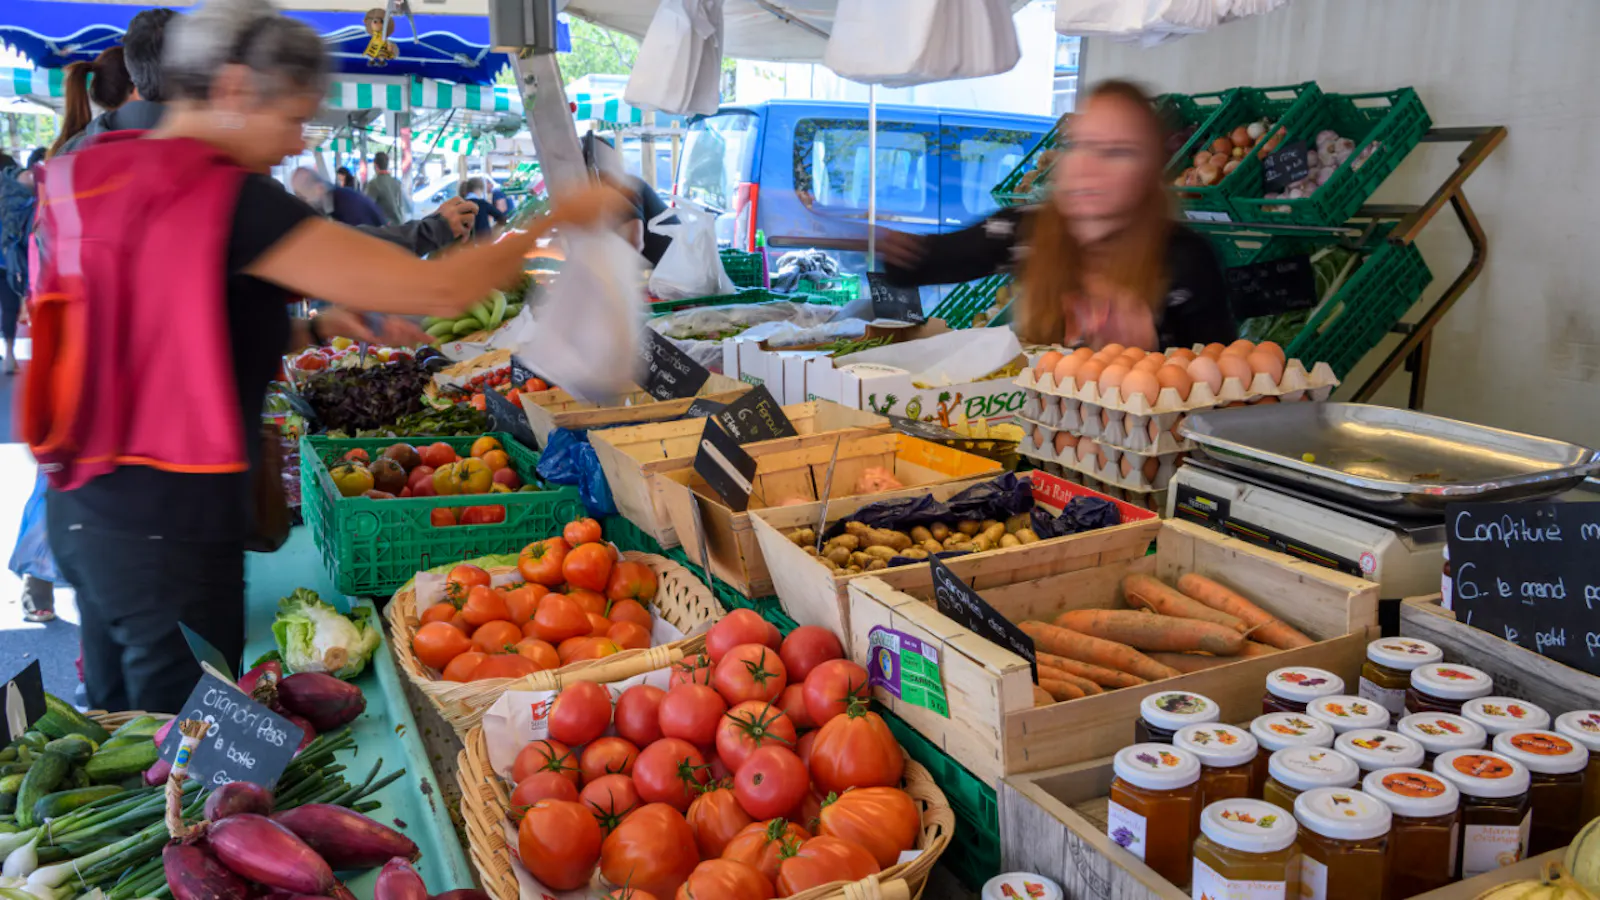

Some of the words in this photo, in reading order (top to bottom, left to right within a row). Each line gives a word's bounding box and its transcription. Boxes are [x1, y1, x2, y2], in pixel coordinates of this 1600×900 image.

[964, 391, 1026, 419] BISC
[1039, 478, 1050, 496] La
[1053, 483, 1073, 503] Ratt
[1497, 577, 1513, 597] le
[1520, 577, 1566, 605] grand
[1535, 627, 1567, 653] petit
[226, 741, 256, 769] botte
